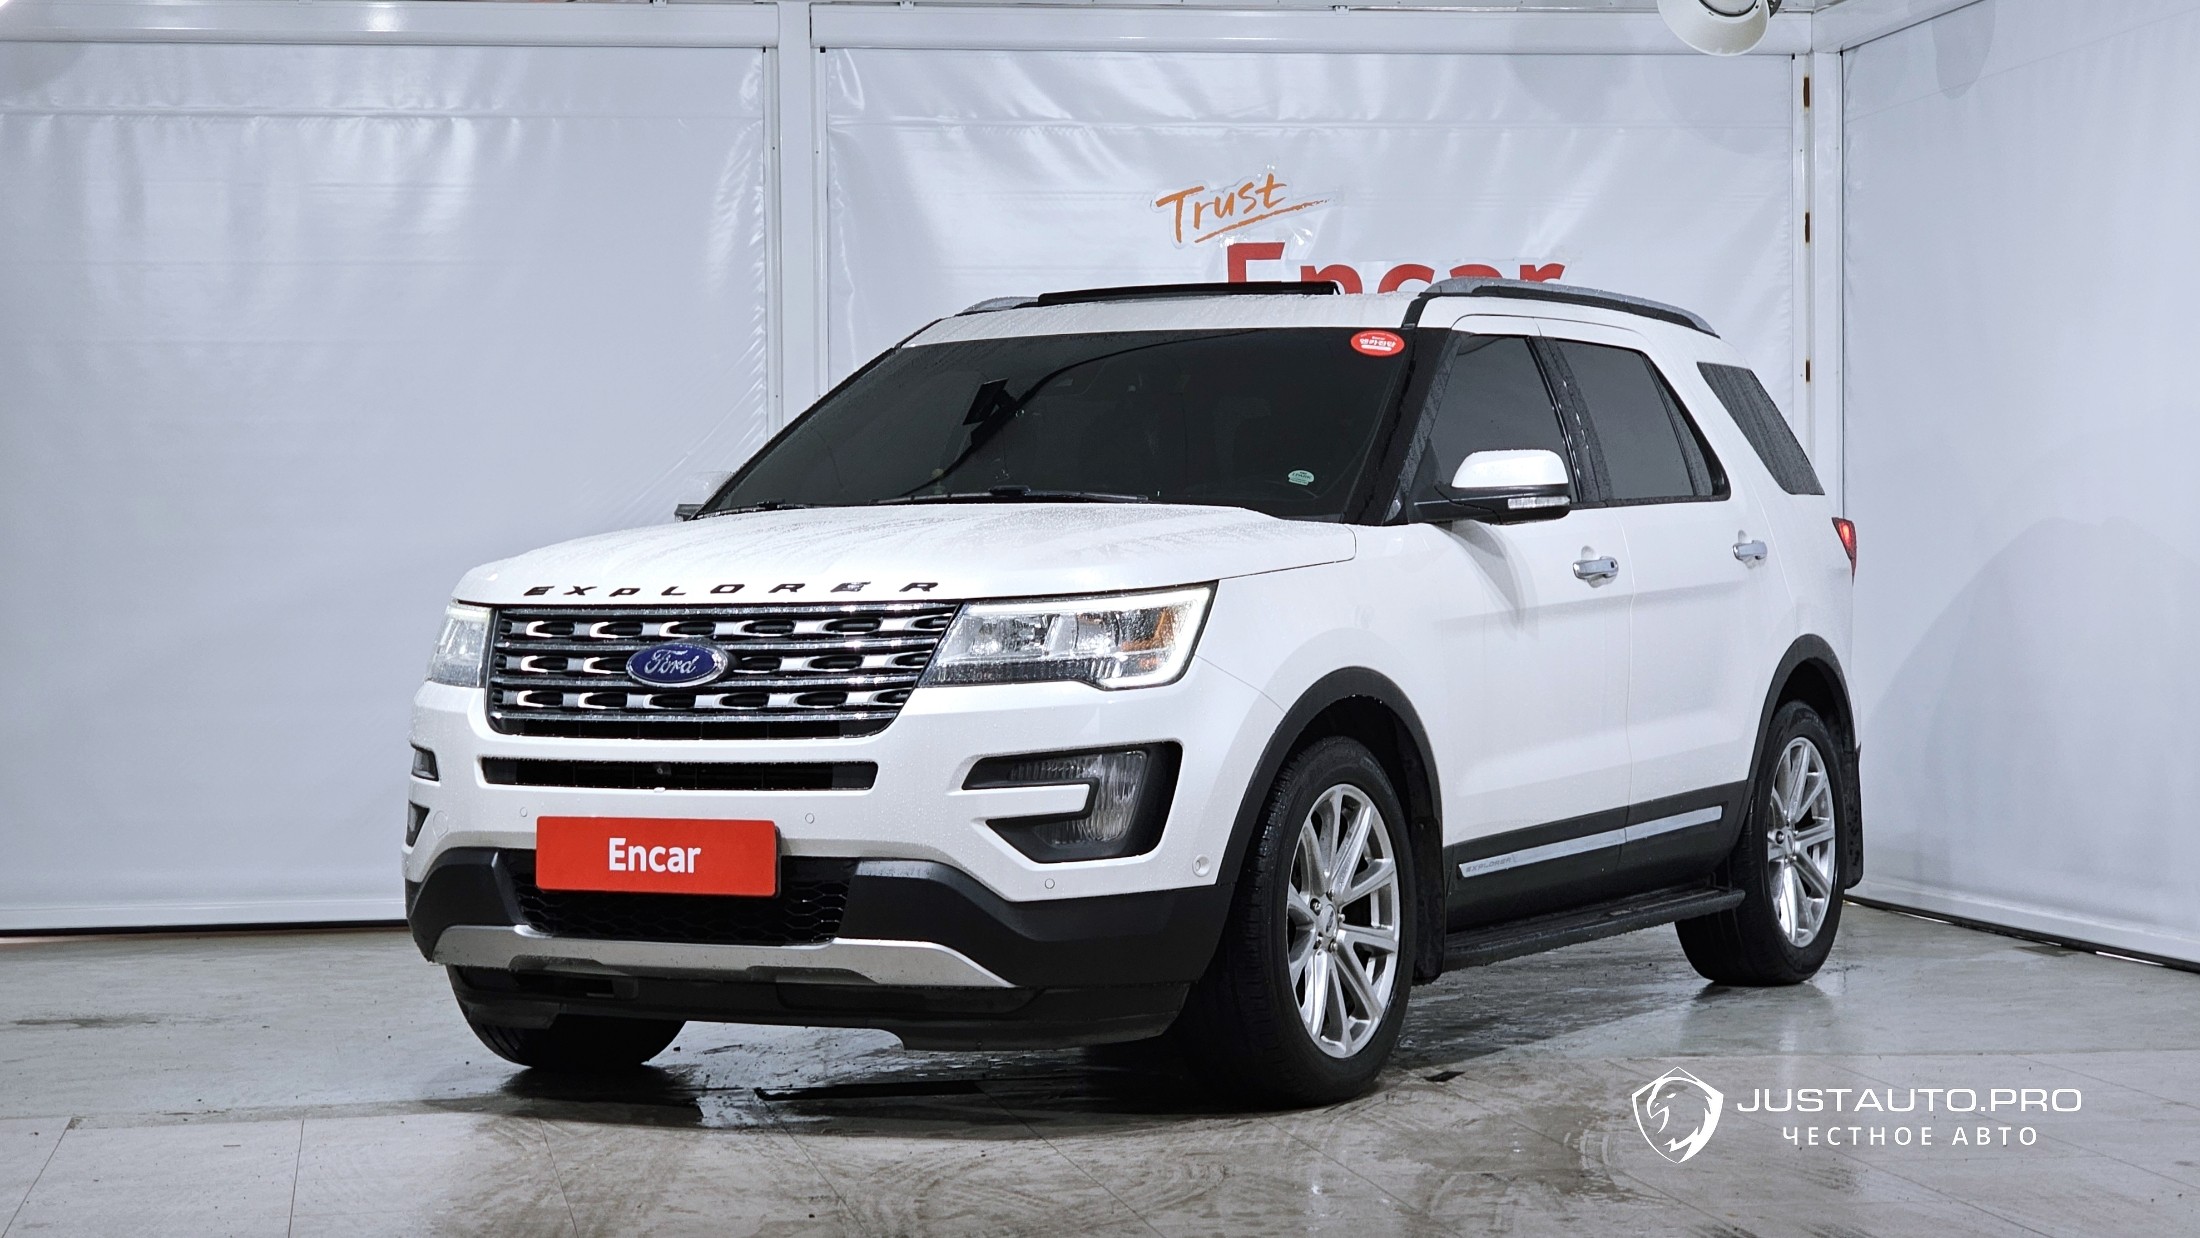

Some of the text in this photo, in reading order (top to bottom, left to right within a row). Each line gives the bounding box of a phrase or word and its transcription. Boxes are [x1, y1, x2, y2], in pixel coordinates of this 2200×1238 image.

[1156, 173, 1287, 243] Trust
[523, 582, 938, 597] EXPLORER
[644, 649, 700, 674] Ford
[609, 837, 701, 874] Encar
